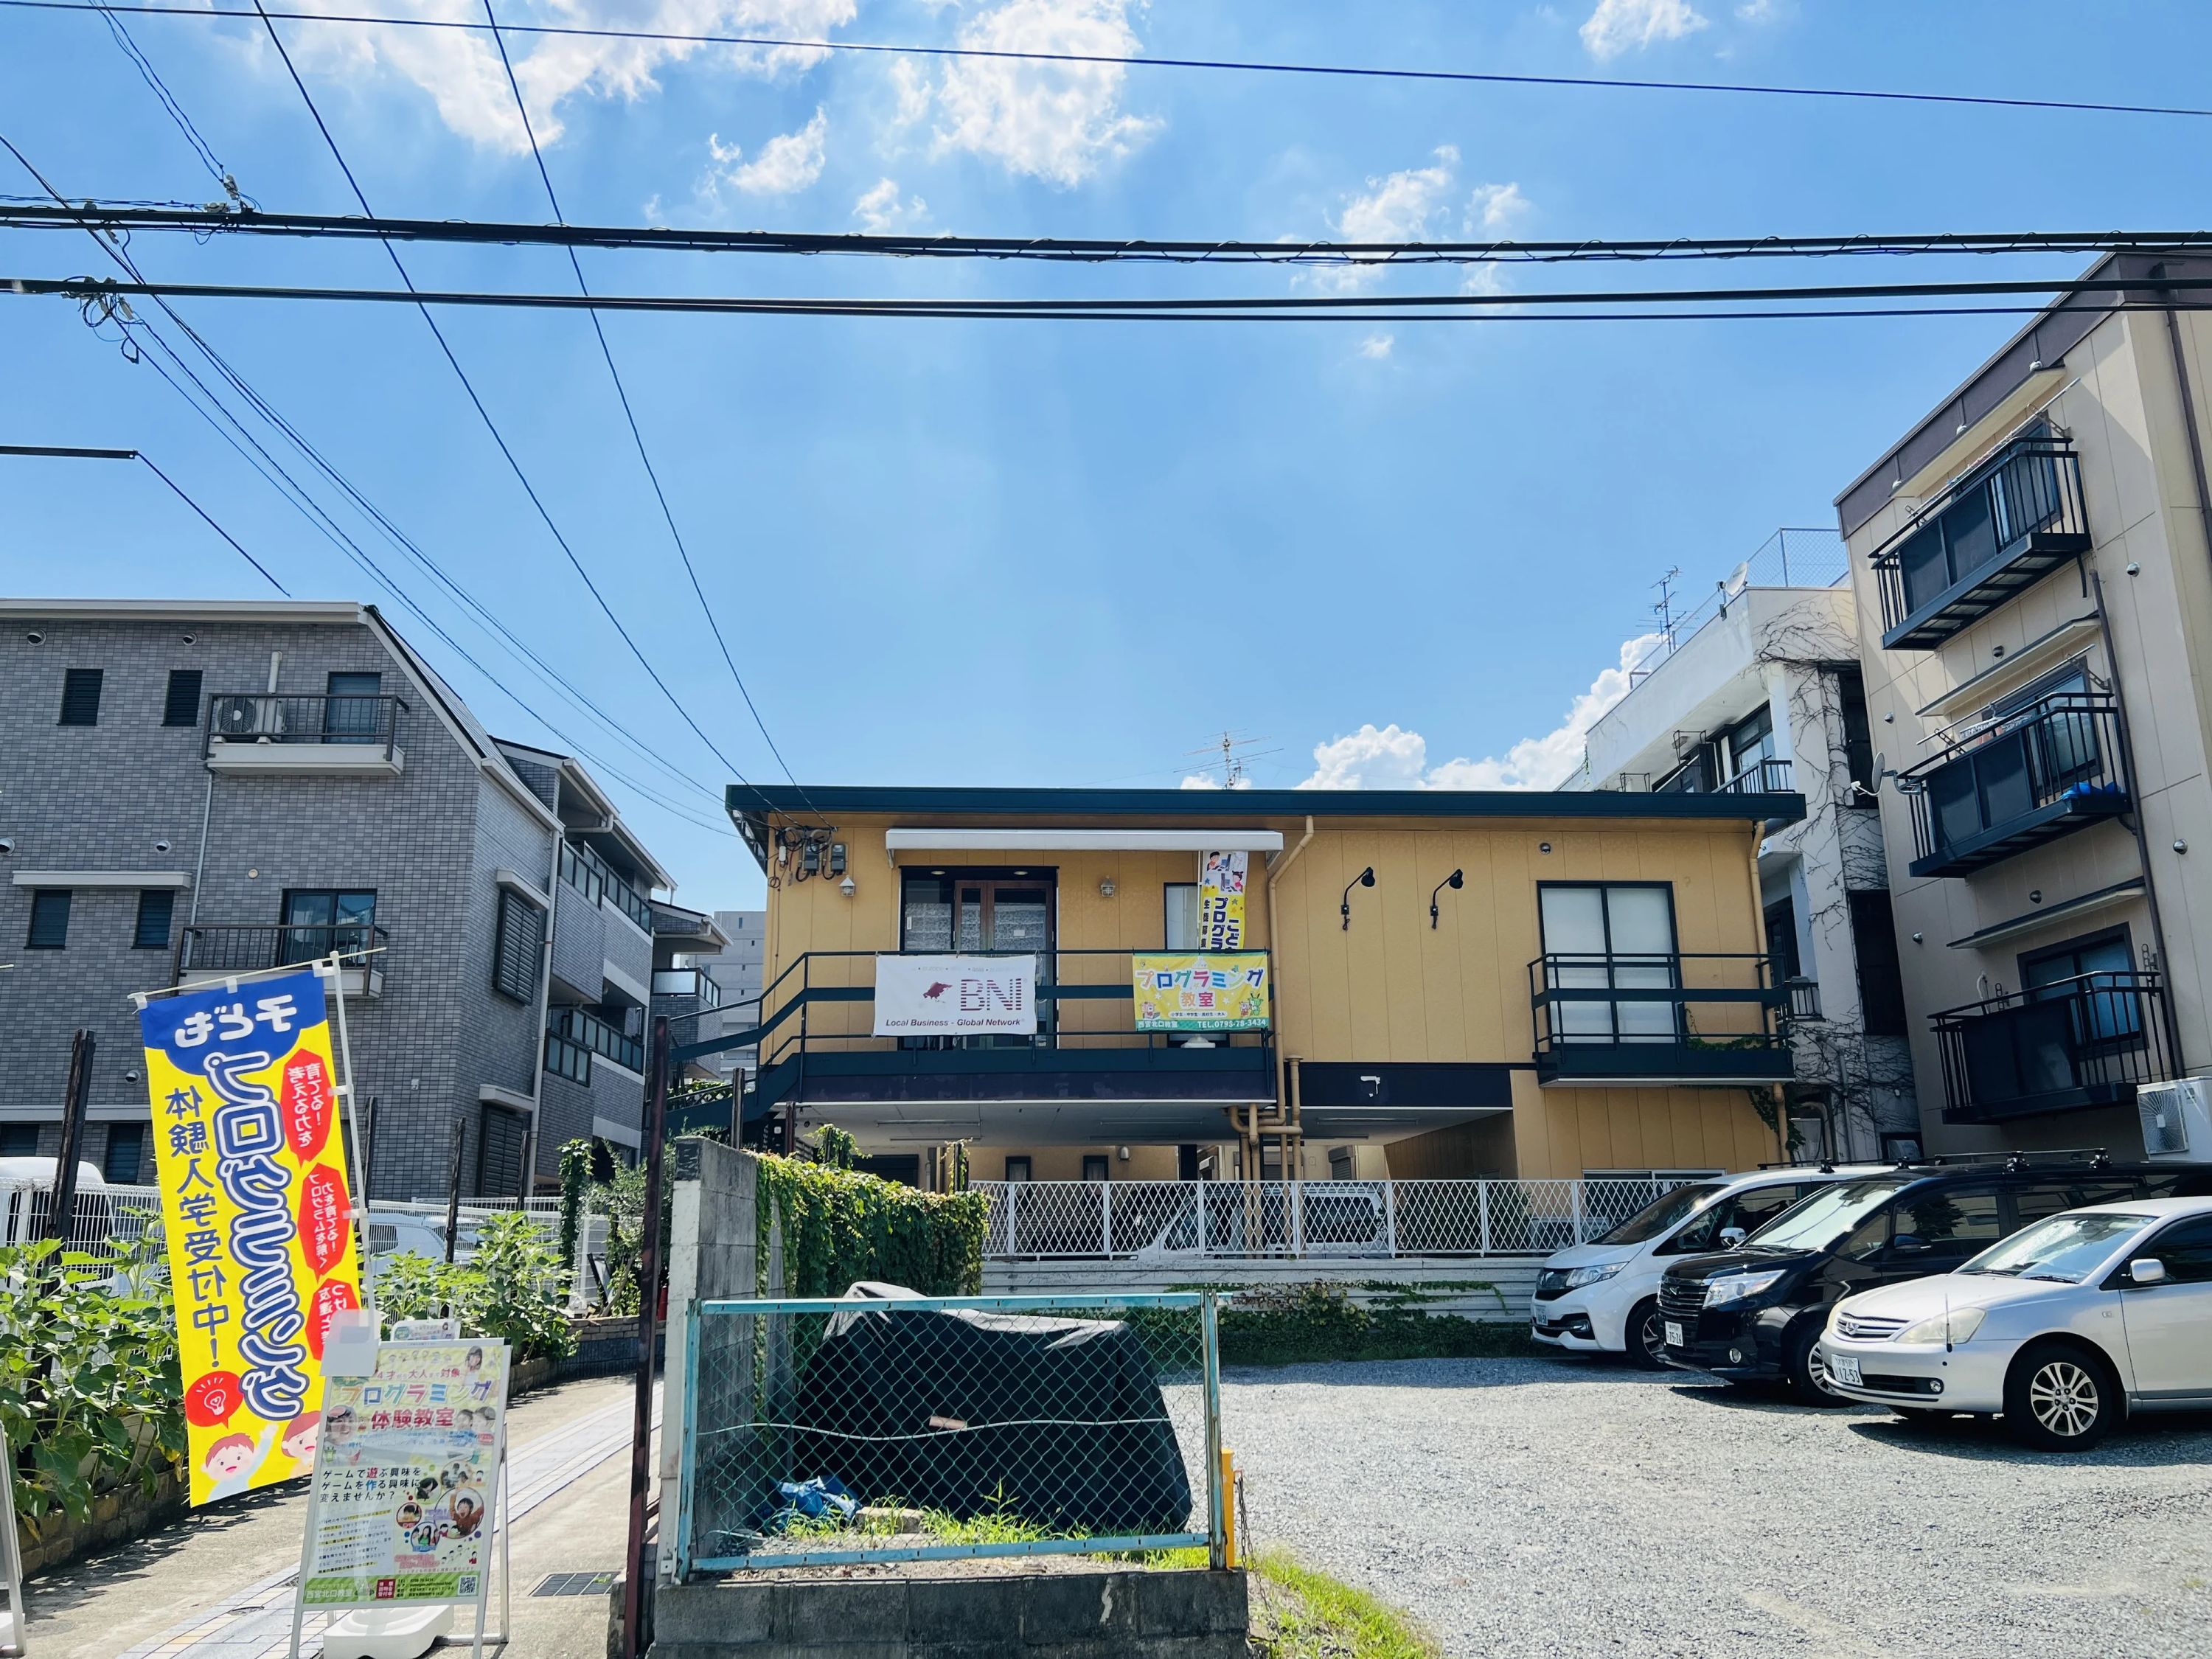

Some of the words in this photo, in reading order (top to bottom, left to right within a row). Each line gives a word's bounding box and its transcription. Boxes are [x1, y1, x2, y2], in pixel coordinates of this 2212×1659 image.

[1225, 919, 1239, 950] こど
[1137, 968, 1264, 989] プログラミング
[960, 978, 1022, 1012] BNI
[1181, 991, 1214, 1007] 教室
[957, 1018, 983, 1026] Global
[985, 1018, 1020, 1026] Network
[341, 1380, 493, 1405] プログラミング
[371, 1406, 456, 1430] 体験教室
[323, 1467, 421, 1480] ゲームで遊ぶ興味を
[321, 1478, 421, 1491] ゲームを作る興味に
